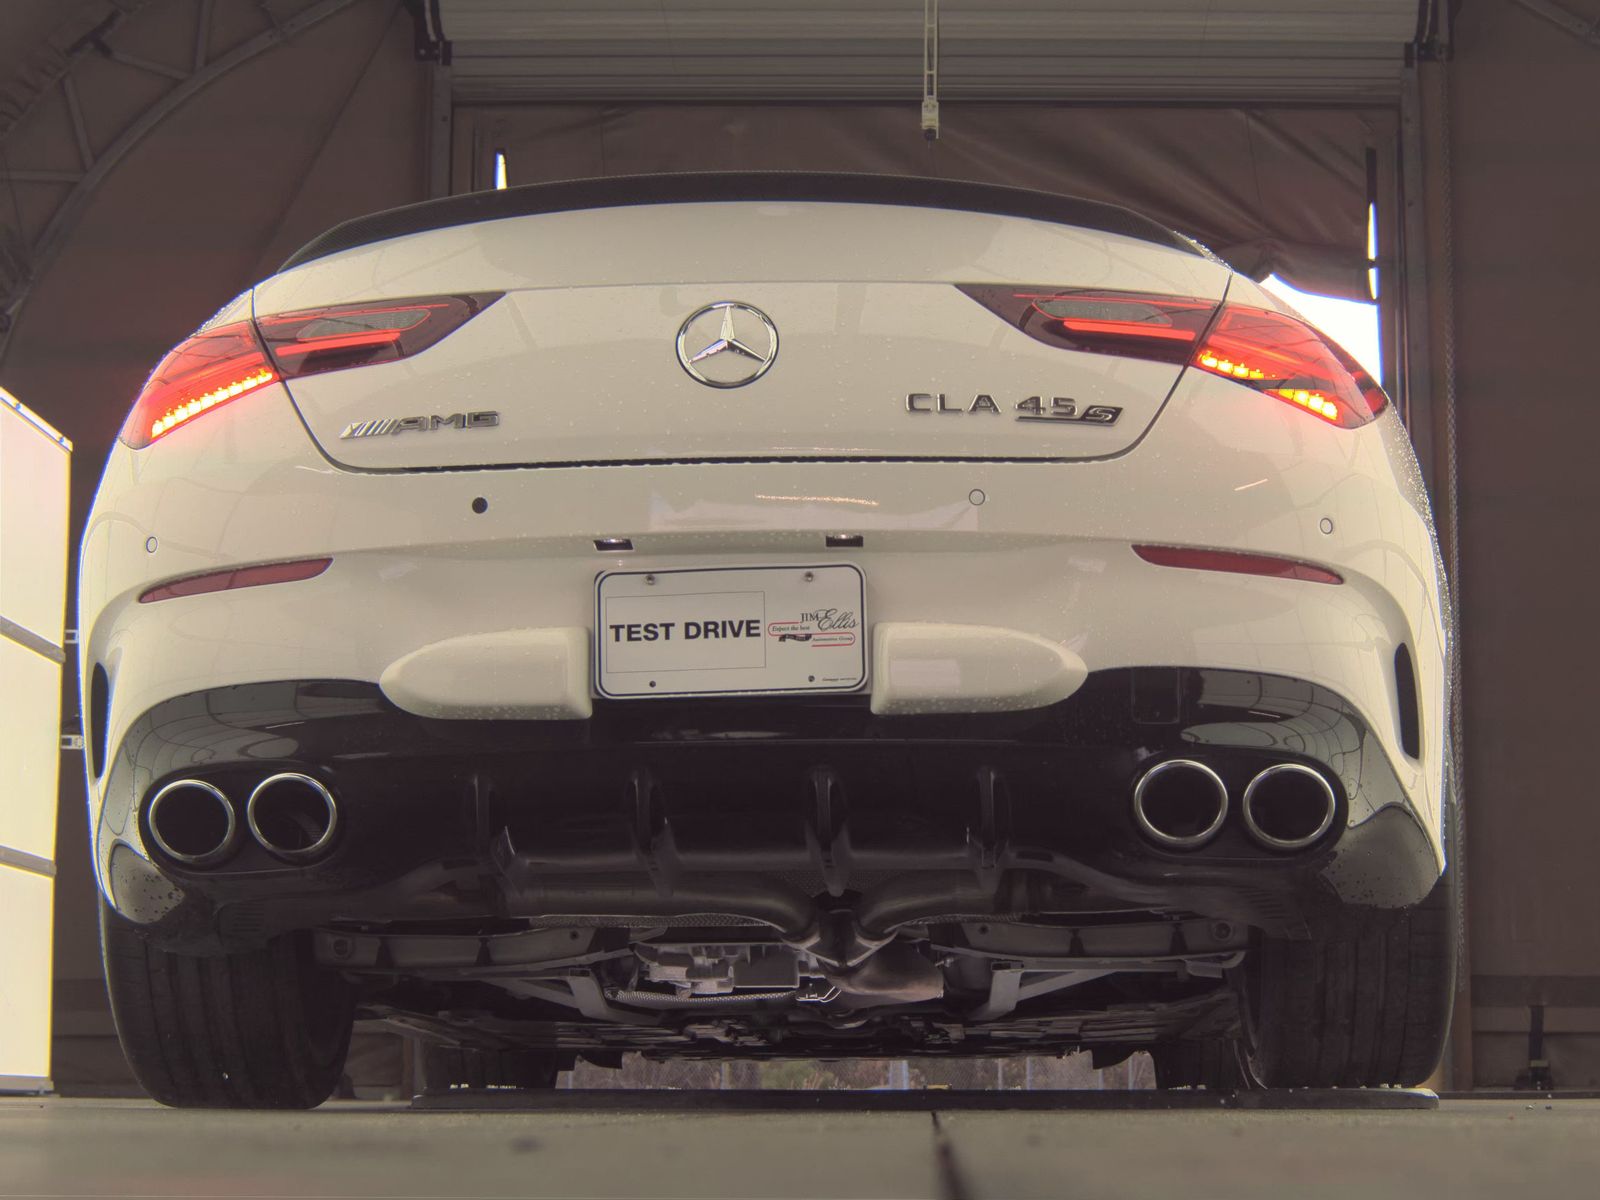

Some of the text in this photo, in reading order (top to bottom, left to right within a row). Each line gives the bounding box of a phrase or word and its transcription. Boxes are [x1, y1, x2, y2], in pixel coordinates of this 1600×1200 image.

[905, 393, 1002, 414] CLA
[389, 410, 500, 435] AMG
[609, 619, 761, 643] TEST DRIVE
[801, 608, 859, 632] JIM Ellis
